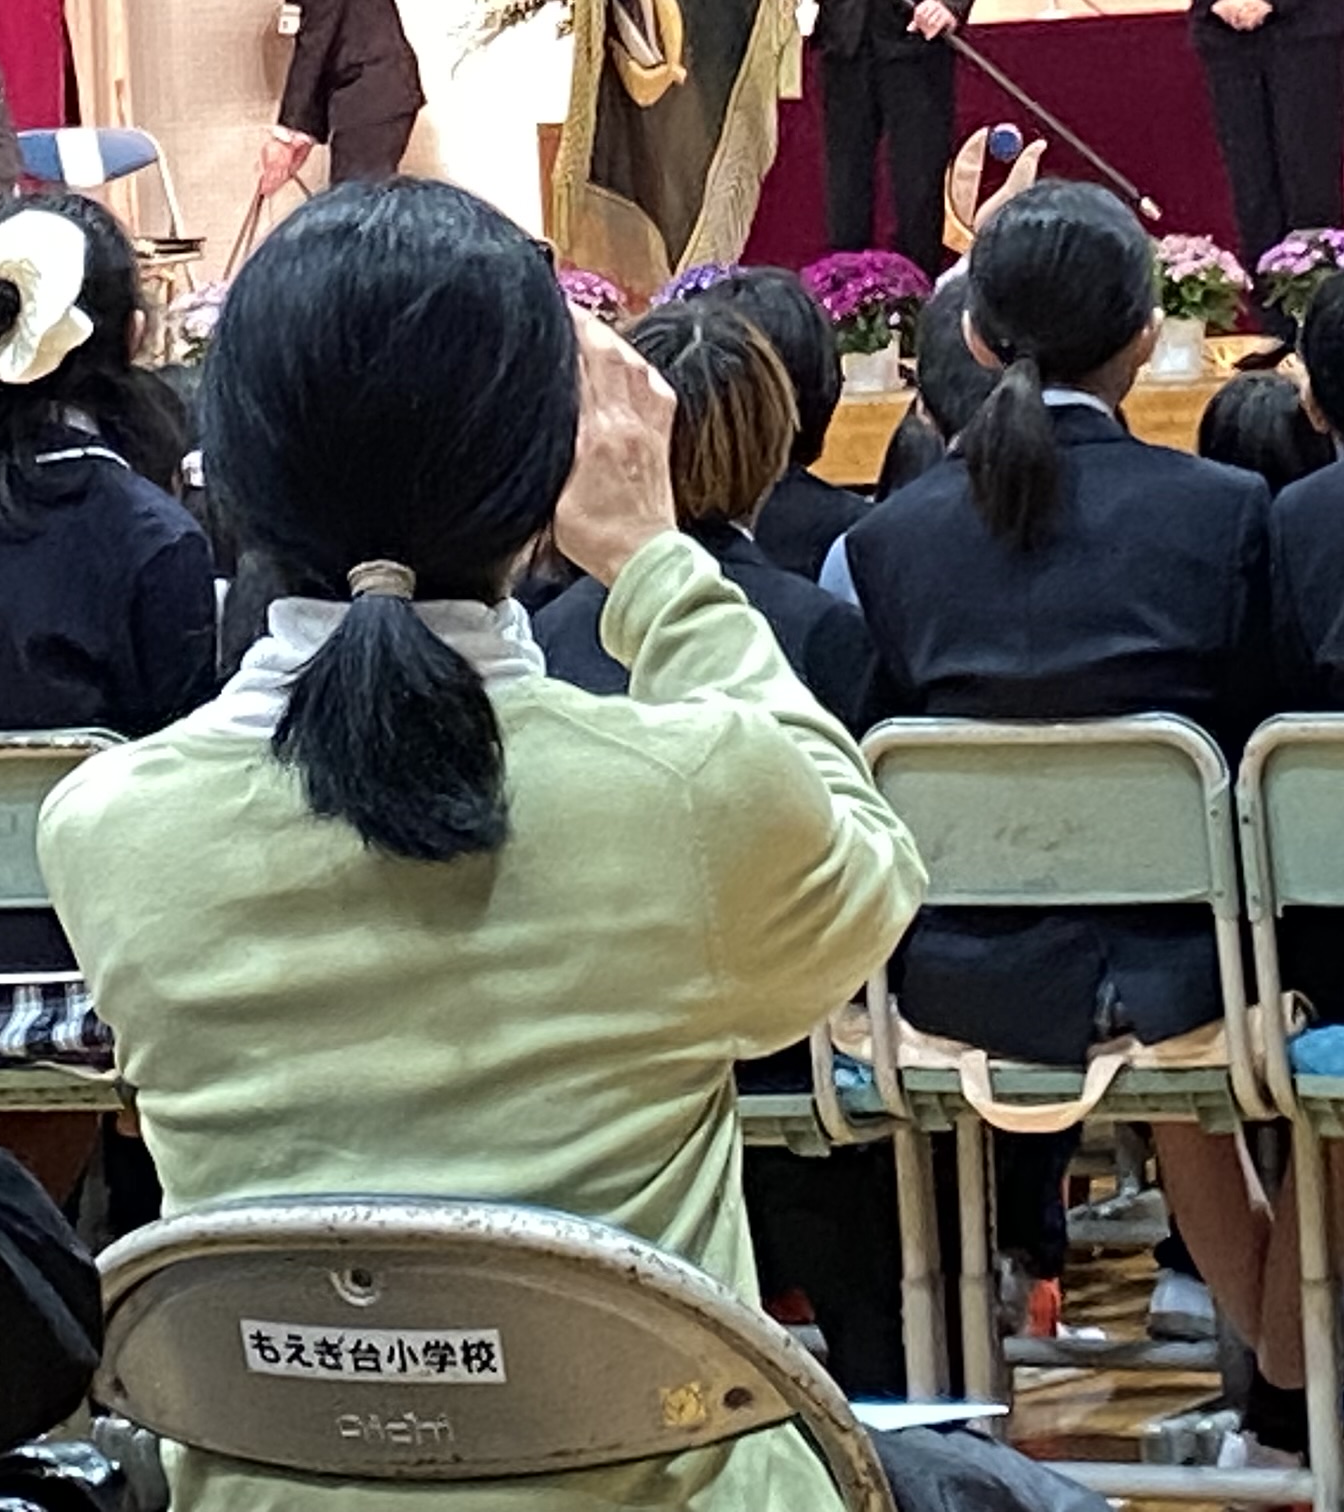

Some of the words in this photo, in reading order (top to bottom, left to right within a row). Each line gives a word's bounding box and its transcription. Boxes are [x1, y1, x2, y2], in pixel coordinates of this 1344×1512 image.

[249, 1329, 498, 1374] もえぎ台小学校
